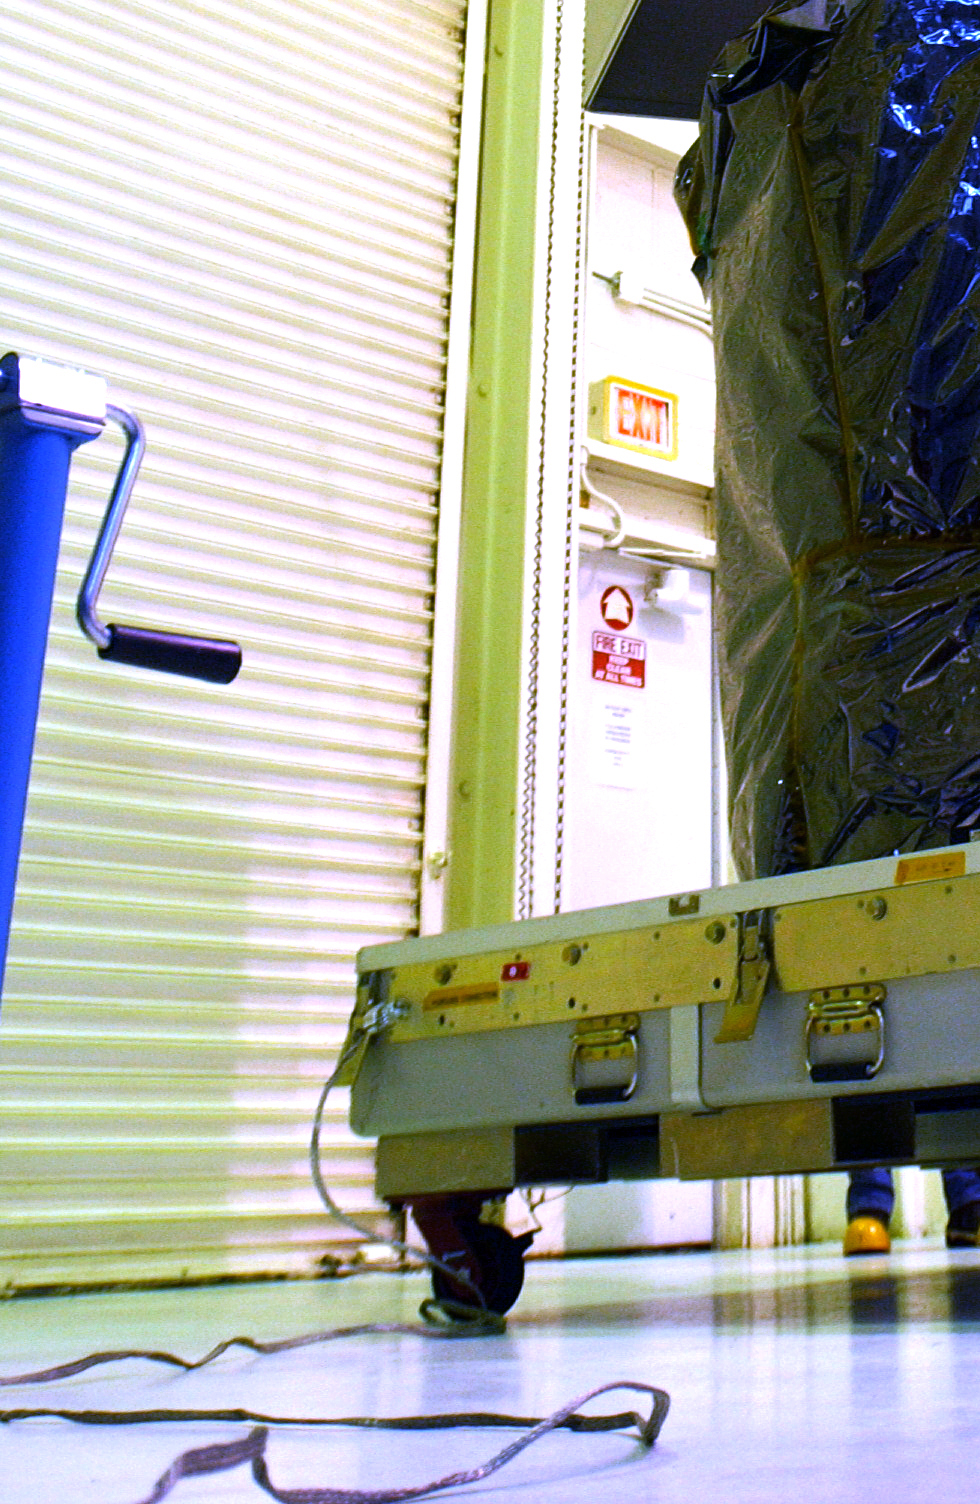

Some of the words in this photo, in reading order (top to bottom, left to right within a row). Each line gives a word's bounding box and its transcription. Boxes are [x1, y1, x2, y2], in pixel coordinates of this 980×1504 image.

[617, 388, 665, 445] EXIT
[596, 634, 616, 653] FIRE
[621, 640, 642, 658] EXIT
